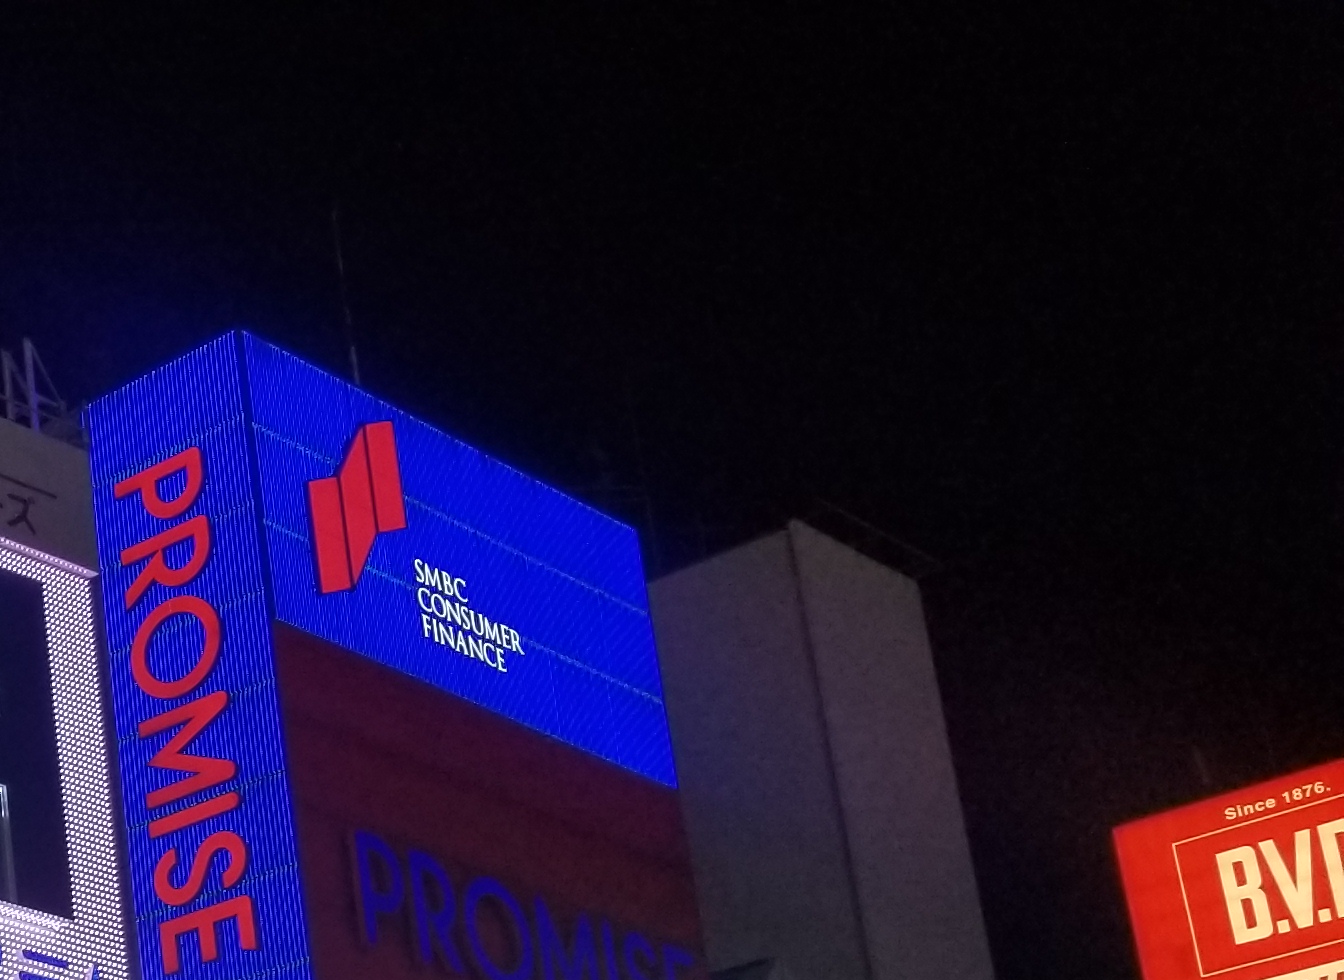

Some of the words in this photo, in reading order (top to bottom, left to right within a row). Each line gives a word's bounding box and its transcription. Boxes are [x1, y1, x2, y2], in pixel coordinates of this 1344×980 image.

[413, 556, 468, 603] SMBC
[417, 588, 525, 656] CONSUMER
[421, 613, 509, 674] FINANCE
[113, 445, 259, 976] PROMISE
[1224, 796, 1276, 820] Since
[1281, 780, 1331, 805] 1876.
